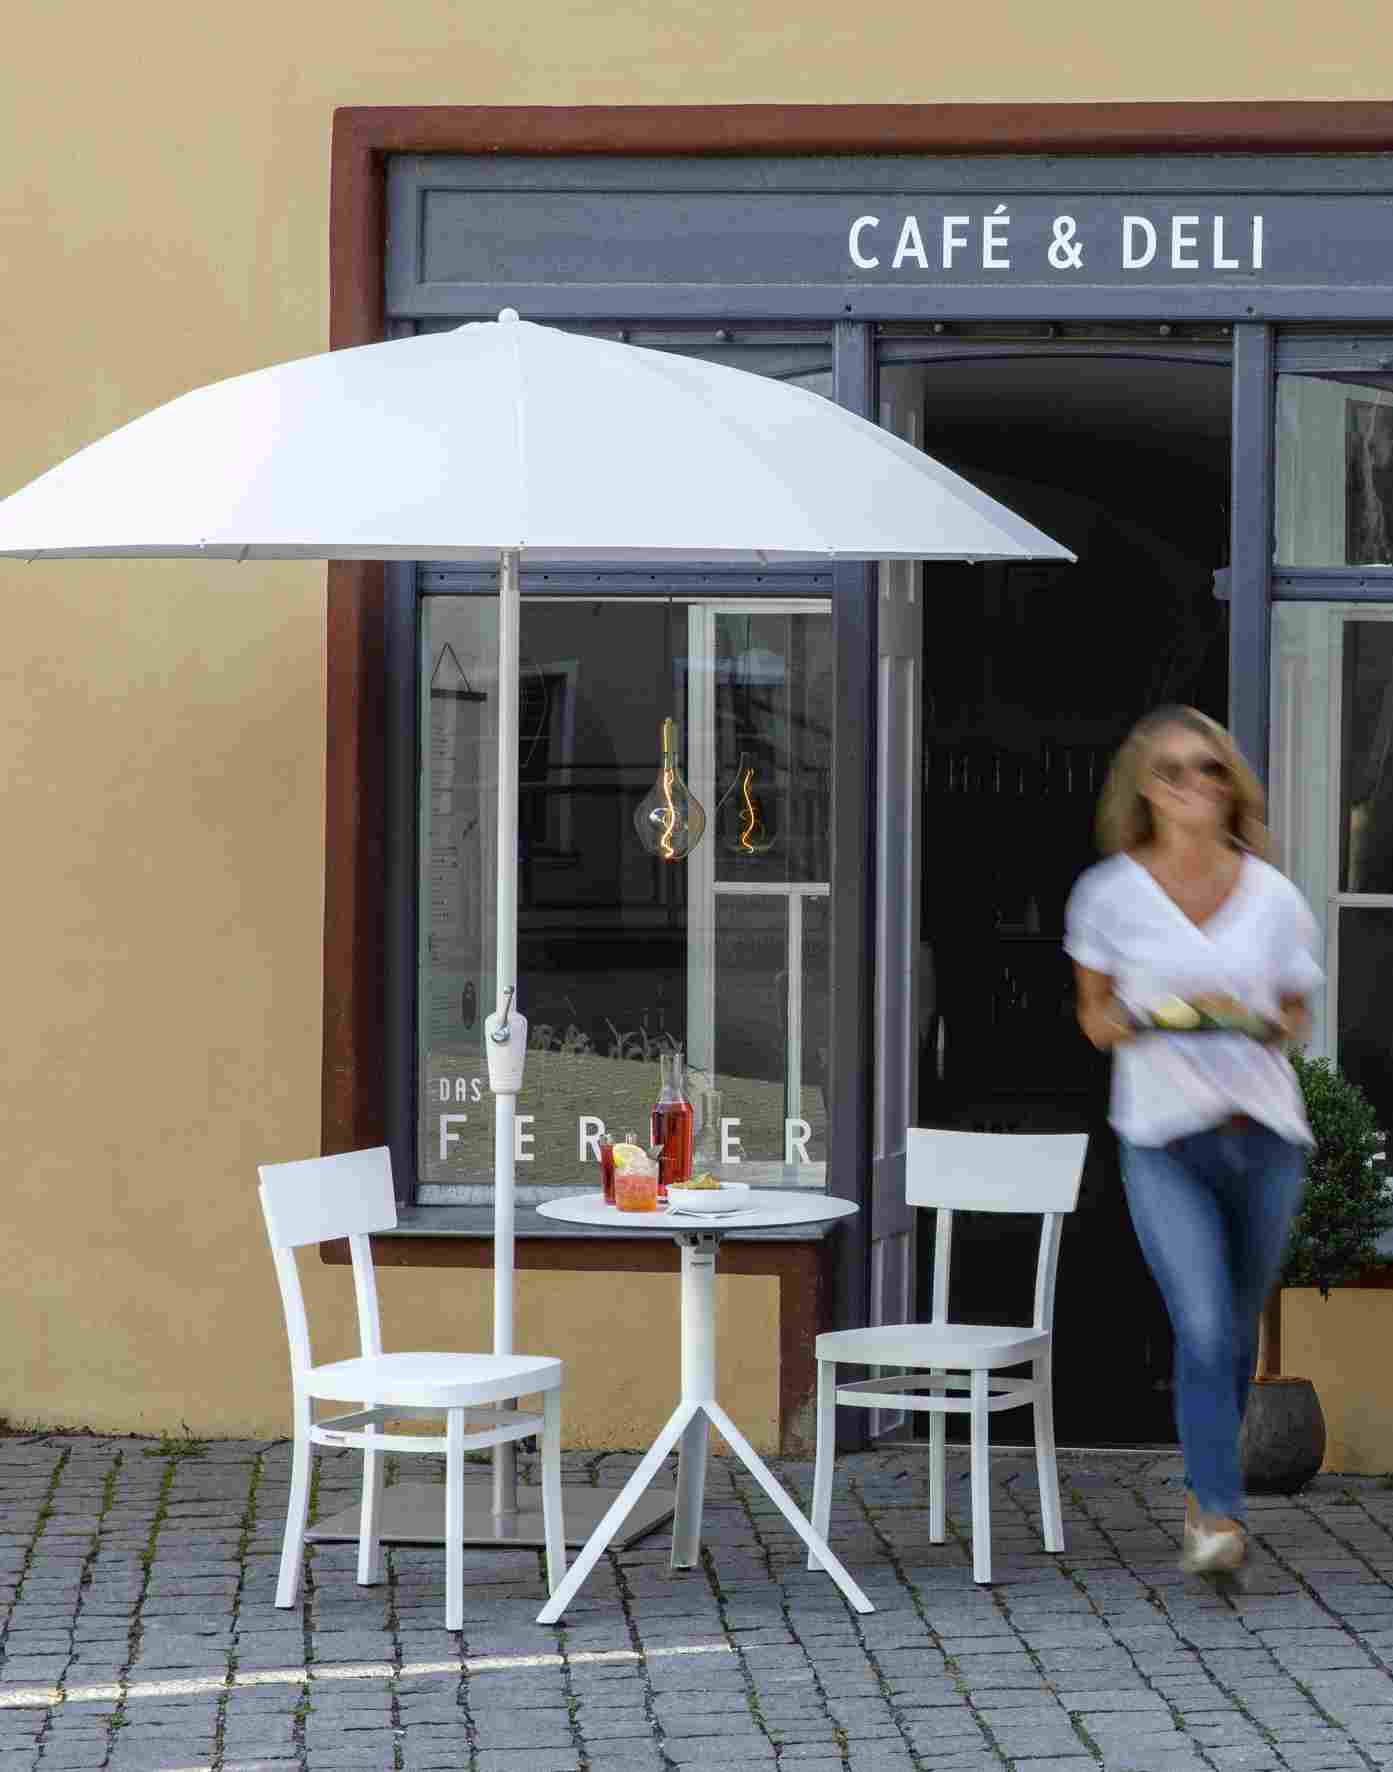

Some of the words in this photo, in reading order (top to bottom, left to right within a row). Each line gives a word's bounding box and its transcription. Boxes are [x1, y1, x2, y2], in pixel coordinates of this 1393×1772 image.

[849, 204, 1010, 269] CAFÉ
[1047, 216, 1083, 269] &
[1122, 216, 1264, 269] DELI
[439, 1078, 482, 1102] DAS
[439, 1114, 812, 1165] FERER
